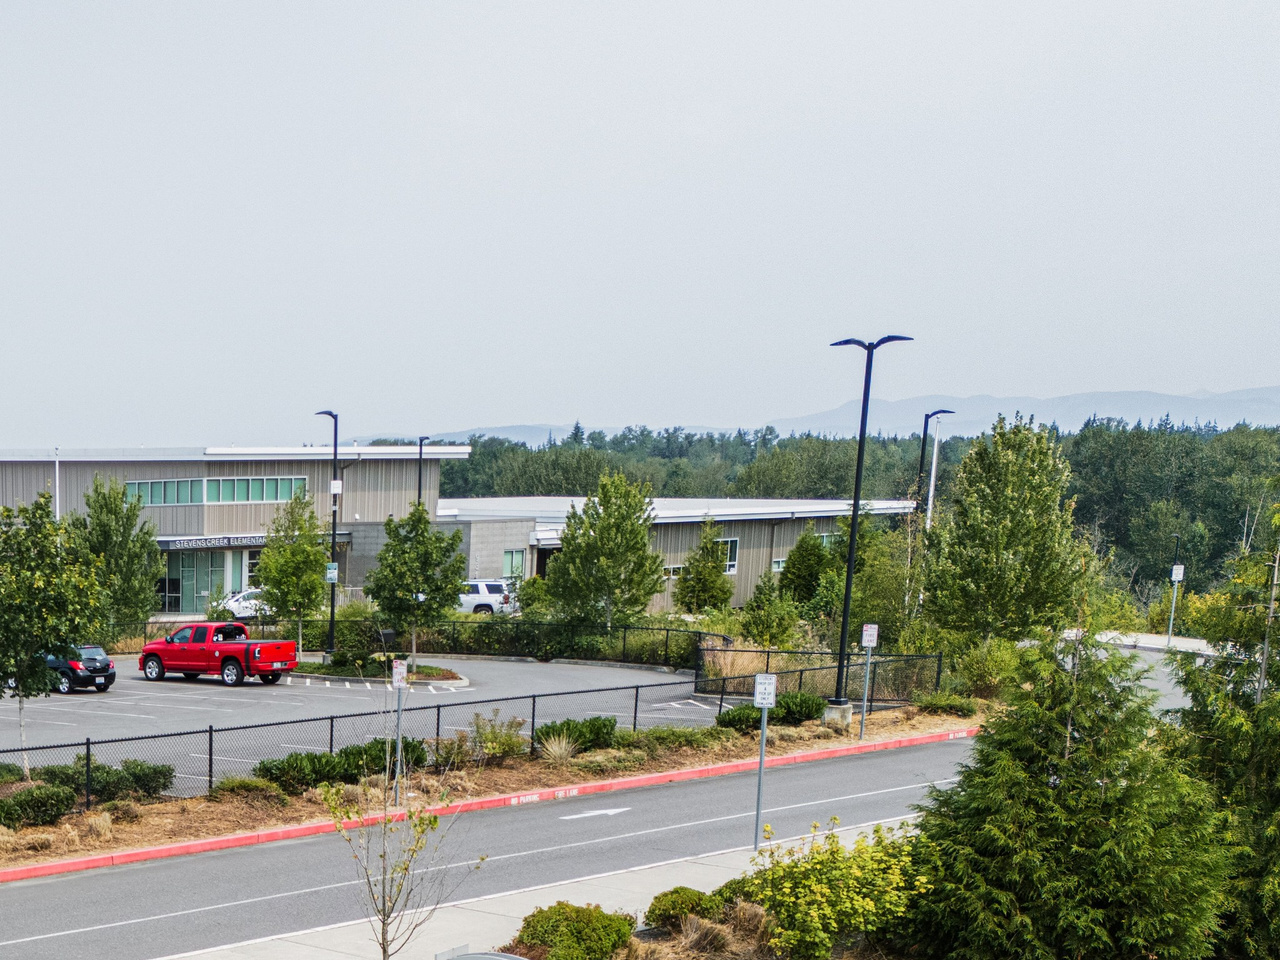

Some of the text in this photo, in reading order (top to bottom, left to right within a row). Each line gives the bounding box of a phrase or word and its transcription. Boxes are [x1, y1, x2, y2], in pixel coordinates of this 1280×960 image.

[175, 536, 267, 548] STEVENS CREEK ELEMENTAR
[520, 794, 539, 803] PARKING
[555, 790, 566, 798] FIRE
[567, 789, 578, 797] LANE
